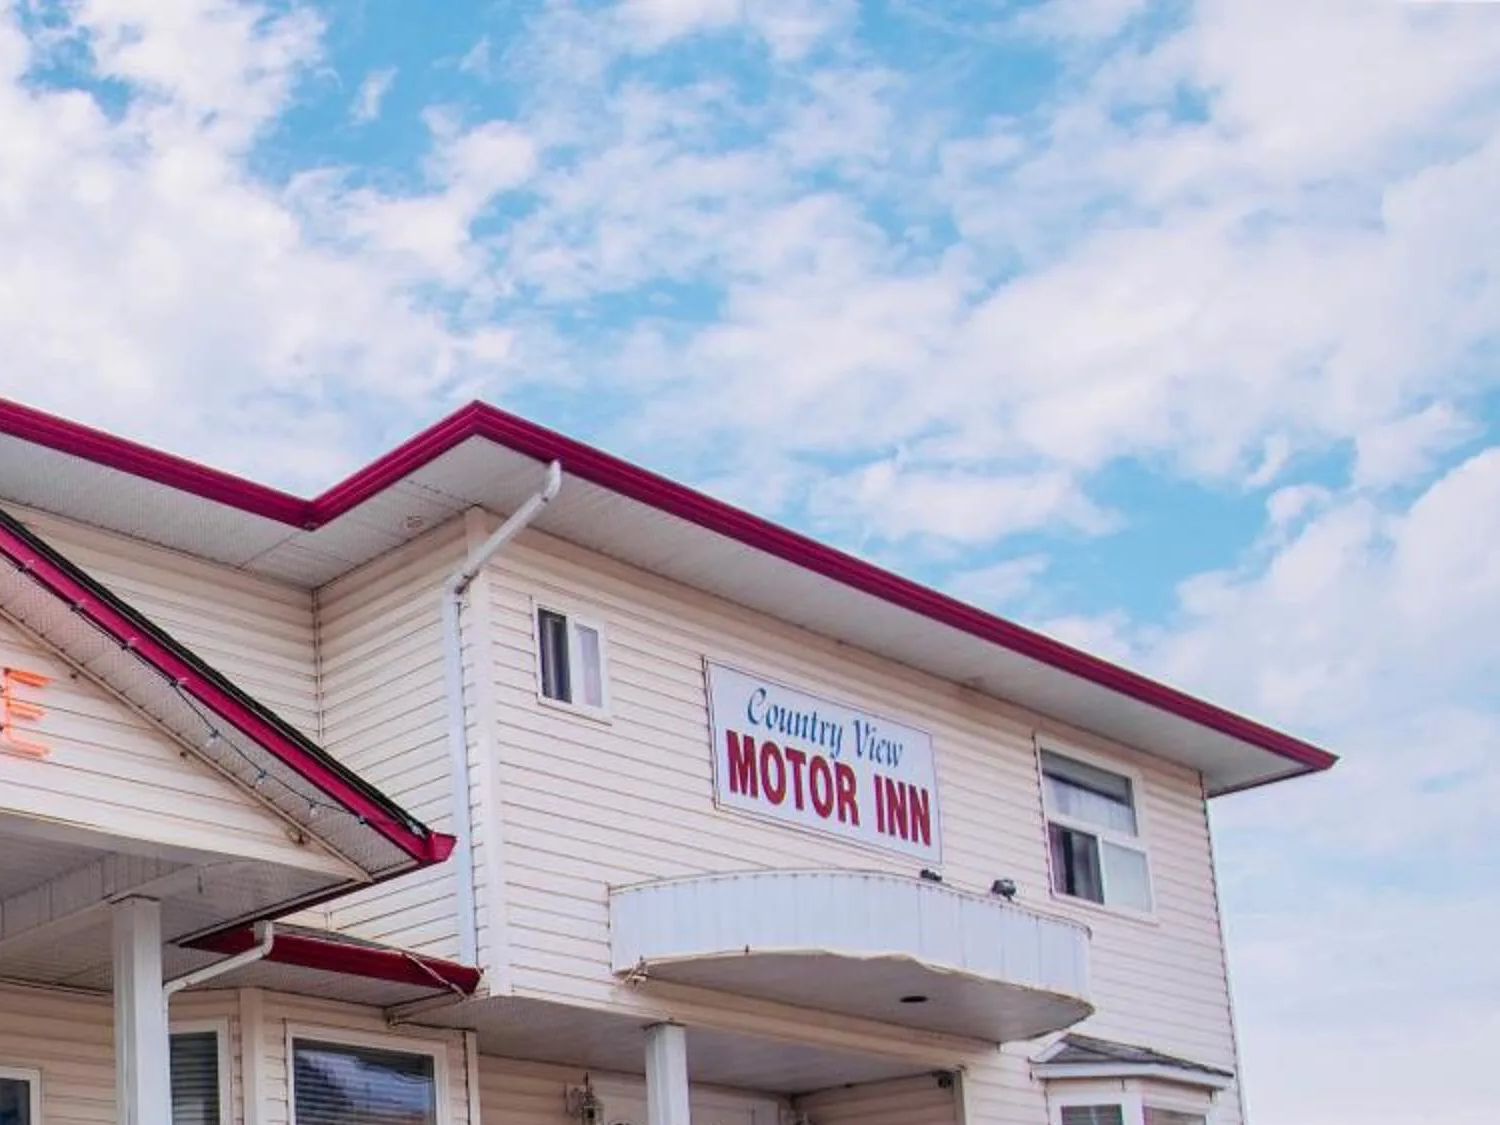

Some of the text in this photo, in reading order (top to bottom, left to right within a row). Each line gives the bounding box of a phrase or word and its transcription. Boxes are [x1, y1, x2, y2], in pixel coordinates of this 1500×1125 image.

[746, 687, 903, 768] Country View
[725, 728, 932, 847] MOTOR INN
